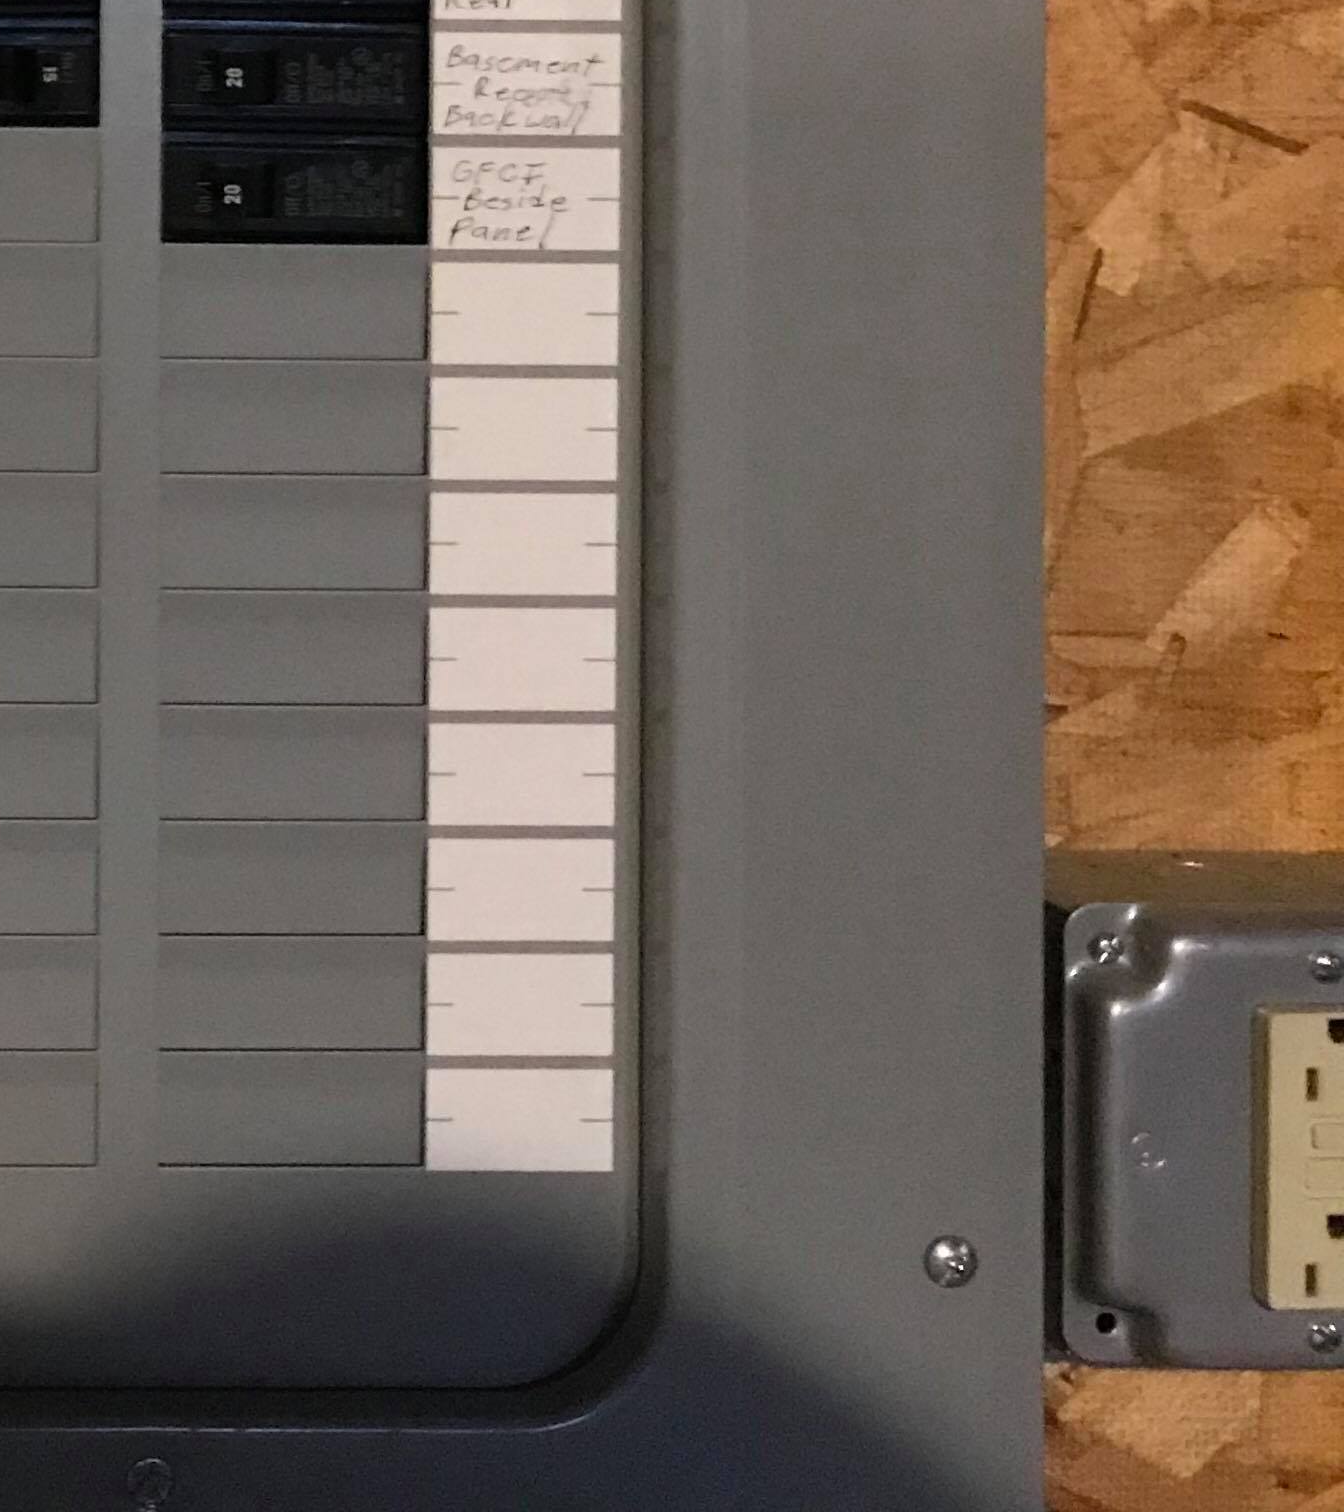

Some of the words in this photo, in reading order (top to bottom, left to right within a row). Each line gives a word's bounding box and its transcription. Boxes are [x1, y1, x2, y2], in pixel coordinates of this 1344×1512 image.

[447, 44, 605, 76] Basement
[225, 67, 244, 88] 20
[223, 183, 242, 205] 20
[463, 184, 569, 213] Beside
[448, 213, 556, 251] Panel
